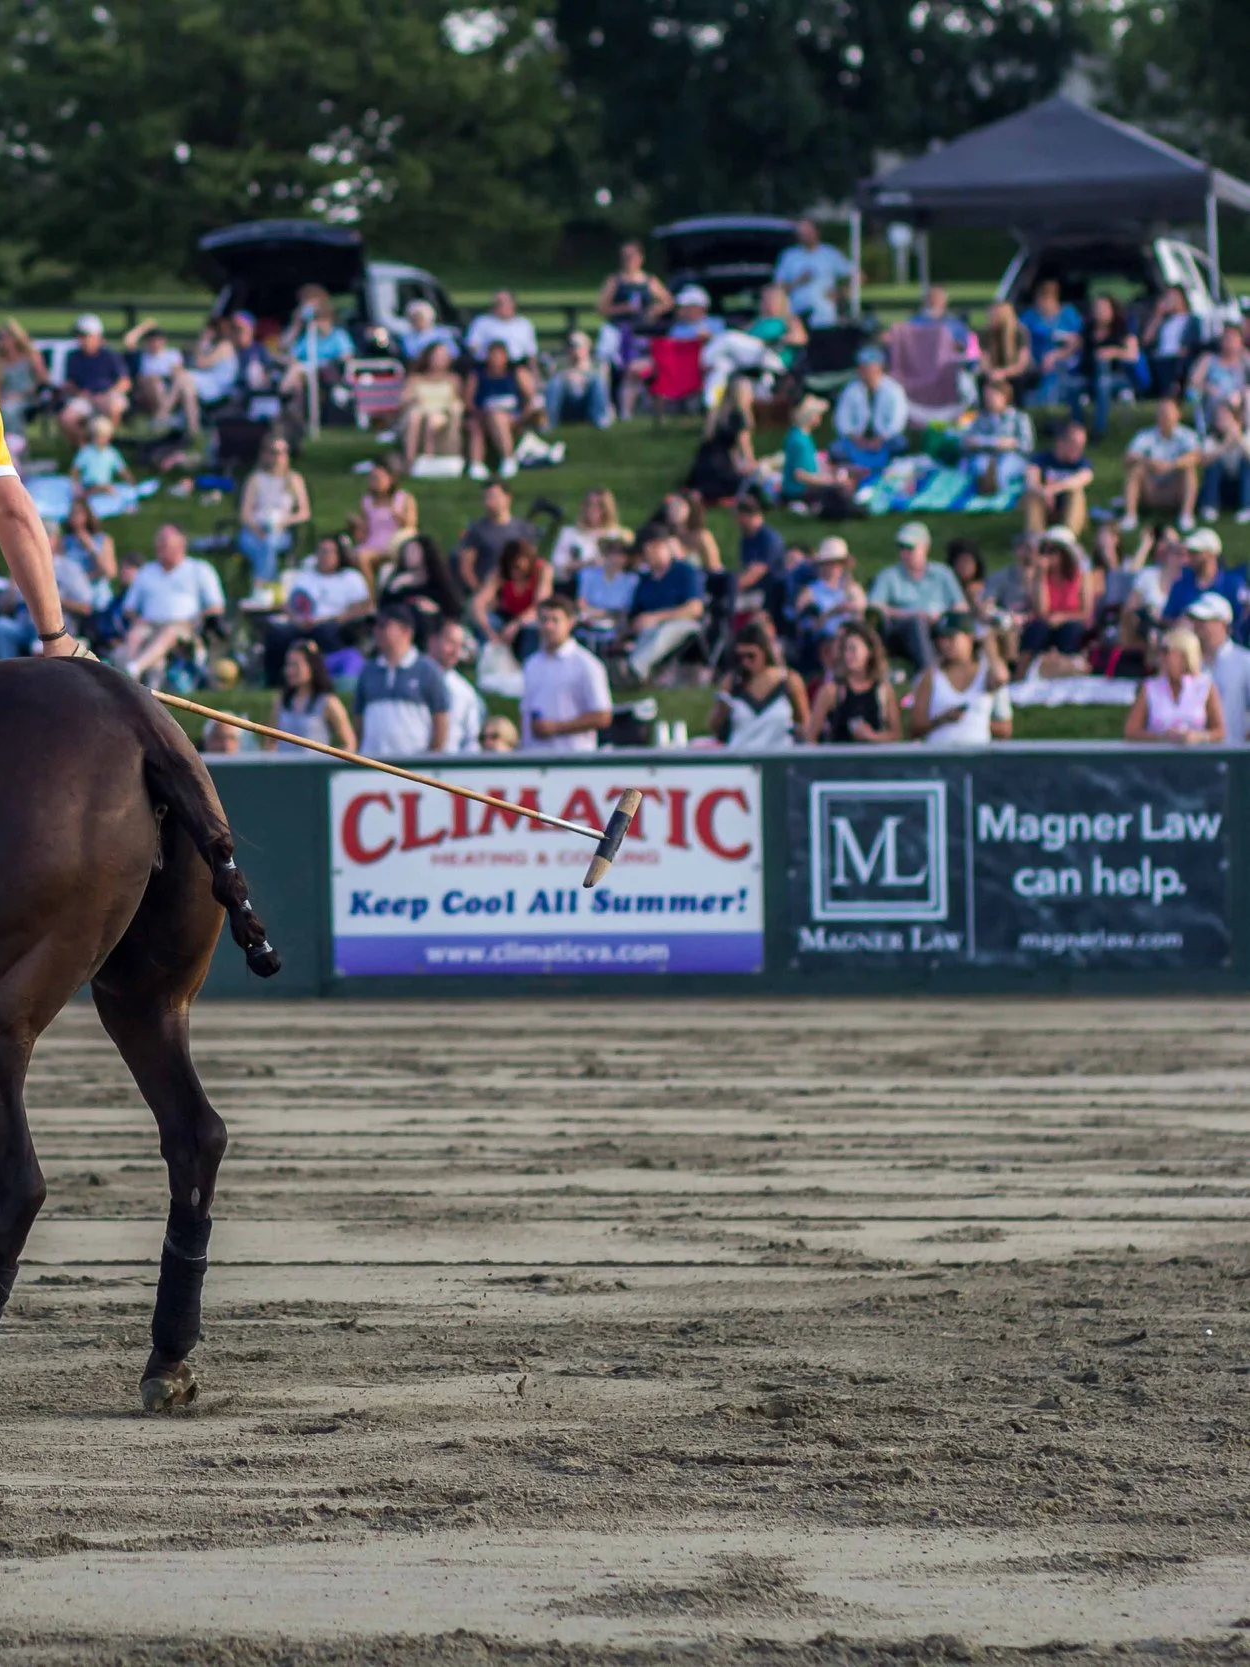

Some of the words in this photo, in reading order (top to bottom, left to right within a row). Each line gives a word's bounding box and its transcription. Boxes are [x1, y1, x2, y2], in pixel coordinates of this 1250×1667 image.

[342, 786, 751, 865] CLIMATIC
[978, 804, 1133, 851] Magner
[1140, 804, 1223, 841] Law
[430, 851, 527, 866] HEATING
[830, 815, 927, 886] ML
[1013, 867, 1083, 896] can
[1092, 855, 1187, 906] help.
[350, 890, 430, 921] Keep
[442, 889, 515, 915] Cool
[528, 889, 577, 914] All
[591, 887, 748, 914] Summer!
[424, 941, 671, 964] www.climaticva.com
[1019, 929, 1184, 954] magnerlaw.com
